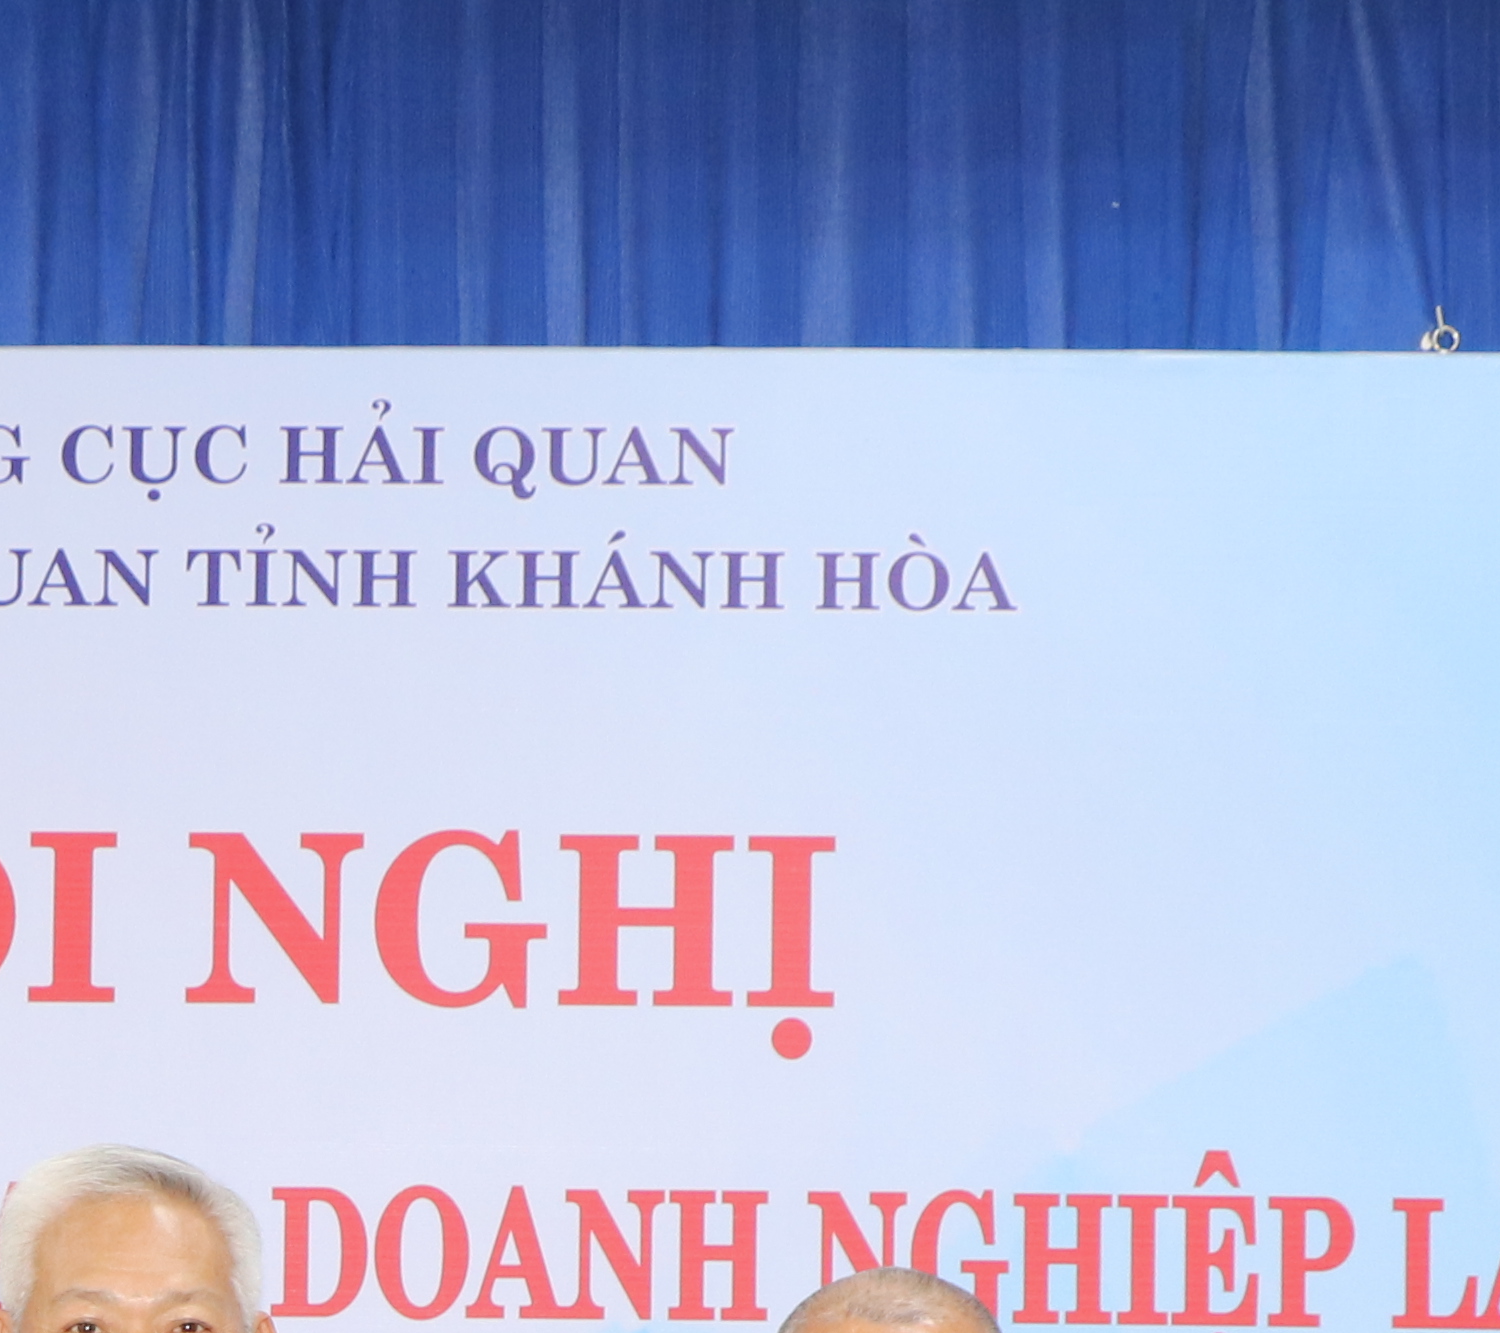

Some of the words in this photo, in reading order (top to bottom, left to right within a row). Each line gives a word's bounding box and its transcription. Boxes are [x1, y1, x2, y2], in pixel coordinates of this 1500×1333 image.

[62, 426, 247, 502] CỤC
[279, 400, 443, 486] HẢI
[475, 427, 731, 500] QUAN
[187, 524, 416, 608] TỈNH
[449, 531, 783, 611] KHÁNH
[817, 534, 1016, 612] HÒA
[186, 829, 836, 1059] NGHỊ
[271, 1184, 768, 1323] DOANH
